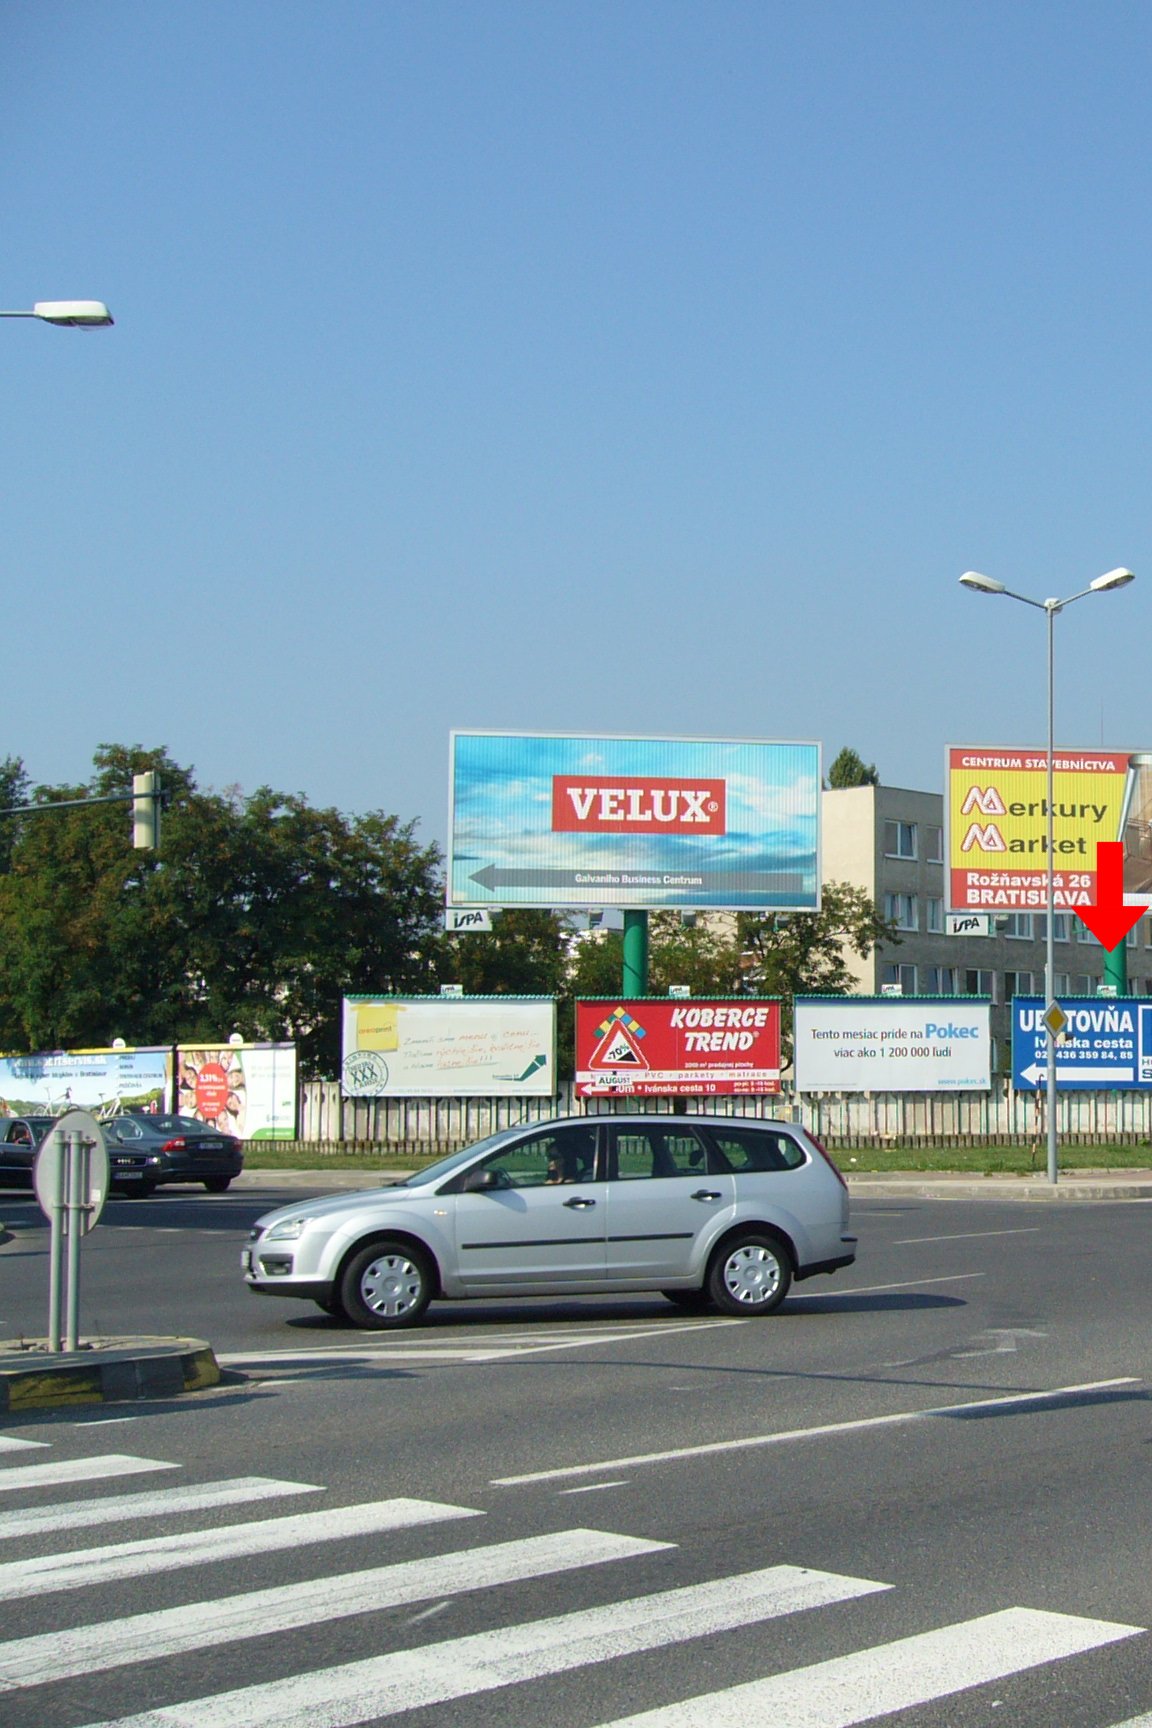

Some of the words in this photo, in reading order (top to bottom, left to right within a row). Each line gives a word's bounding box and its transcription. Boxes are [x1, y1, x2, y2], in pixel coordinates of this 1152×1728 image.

[962, 756, 1022, 768] CENTRUM
[566, 787, 711, 822] VELUX
[961, 785, 1108, 823] Merkury
[961, 822, 1087, 854] Market
[621, 874, 661, 885] Business
[663, 875, 702, 885] Centrum
[1068, 874, 1091, 888] 26
[670, 1008, 769, 1028] KOBERCE
[1019, 1005, 1134, 1033] UBTOVŇA
[812, 1029, 840, 1040] Tento
[842, 1028, 878, 1039] mesiac
[910, 1031, 923, 1039] na
[925, 1023, 979, 1039] Pokec
[685, 1032, 754, 1052] TREND
[1094, 1038, 1133, 1049] cesta
[834, 1047, 854, 1058] viac
[858, 1047, 876, 1058] ako
[880, 1047, 885, 1057] 1
[889, 1047, 908, 1057] 200
[911, 1047, 930, 1057] 000
[1056, 1051, 1077, 1059] 436
[1079, 1051, 1099, 1059] 359
[1101, 1051, 1117, 1060] 84,
[645, 1071, 664, 1079] PVC
[678, 1071, 715, 1081] parkety
[644, 1084, 678, 1093] Ivánska
[680, 1084, 704, 1093] cesta
[705, 1084, 716, 1092] 10
